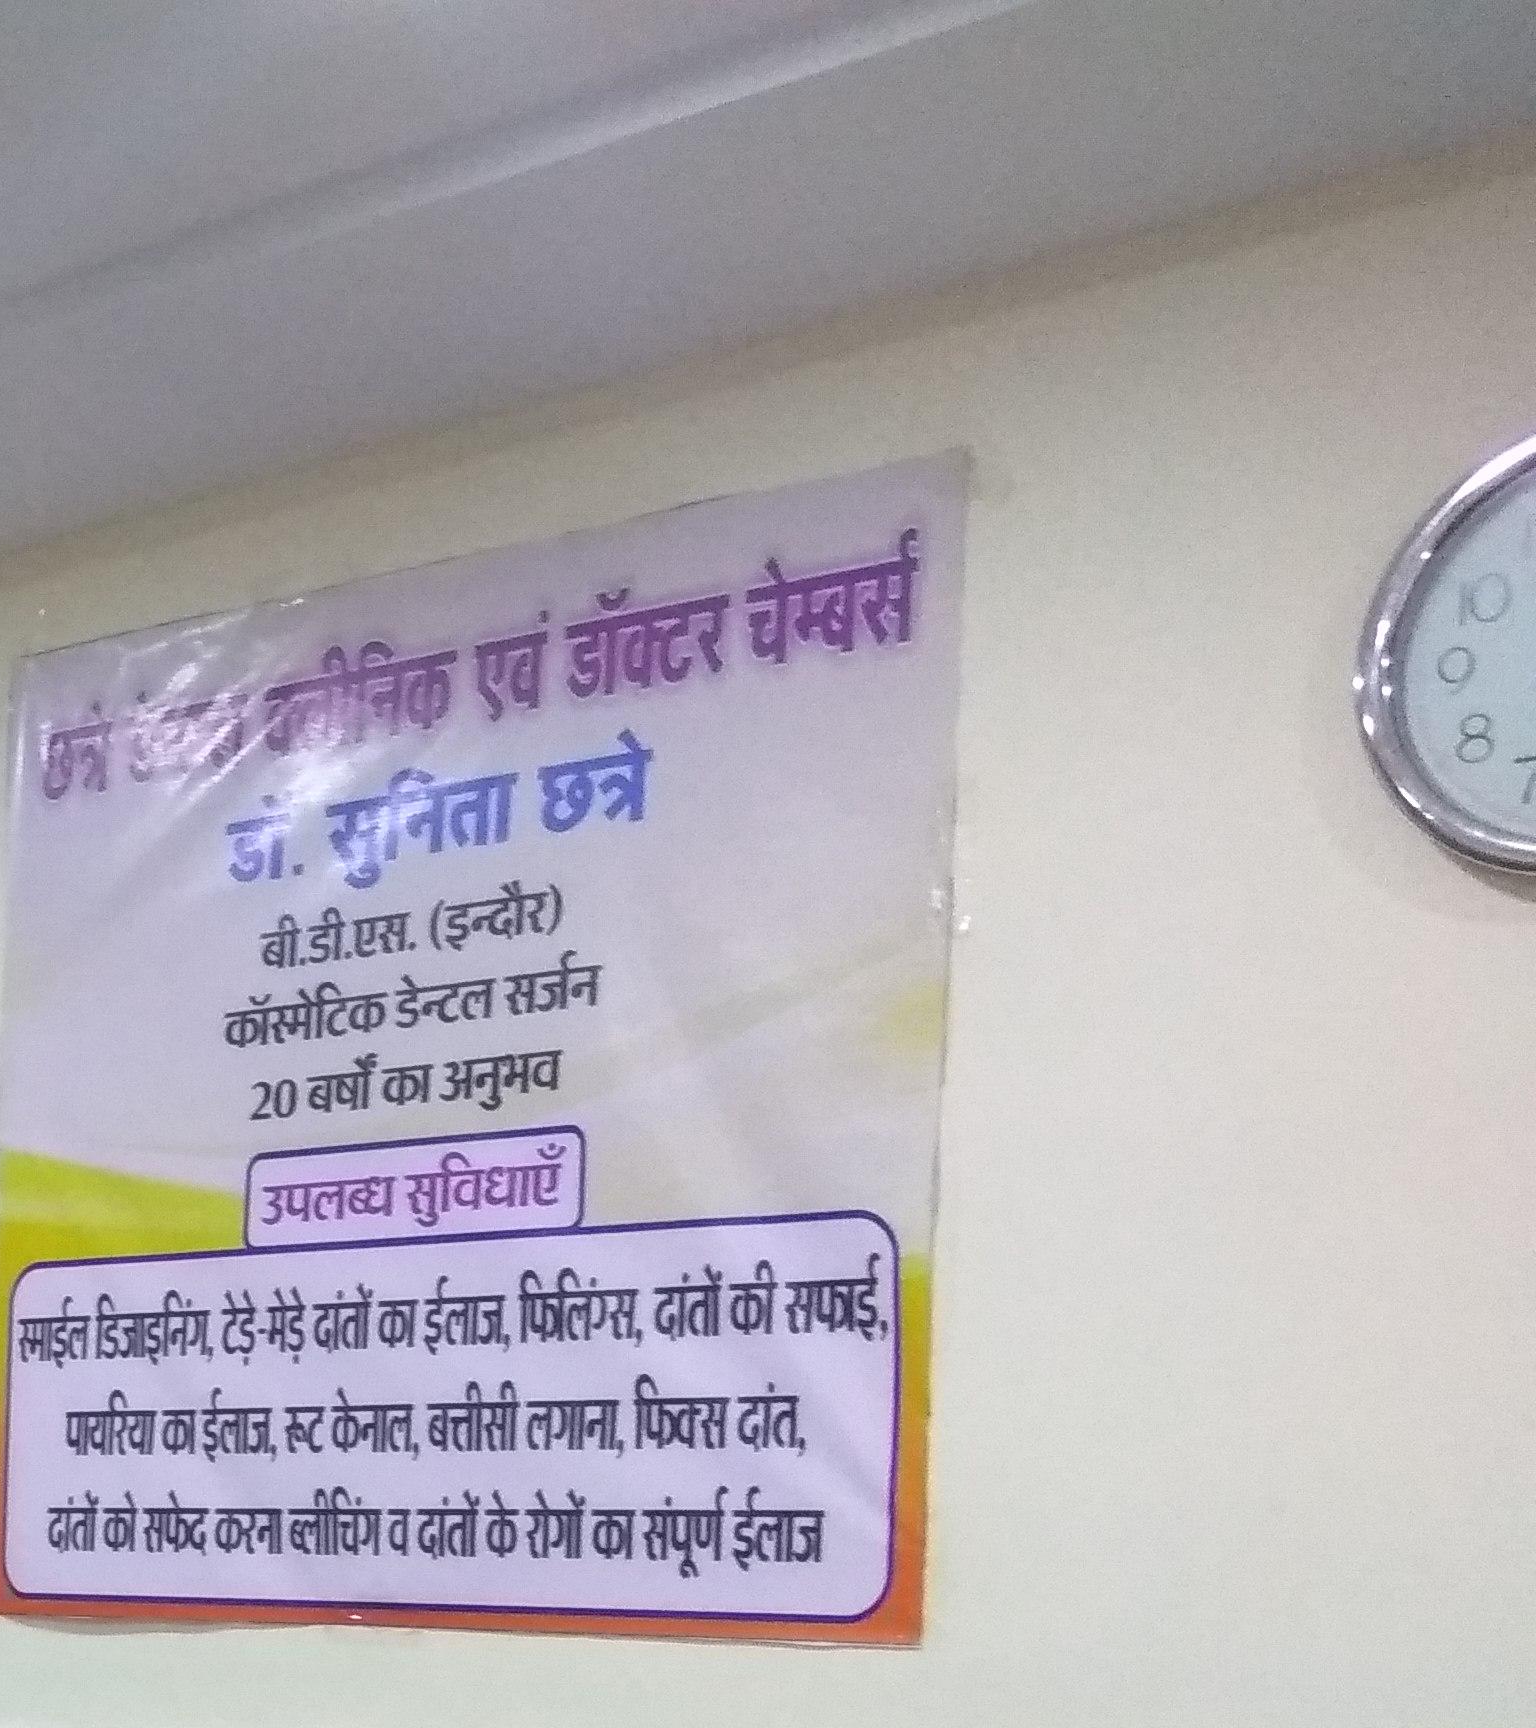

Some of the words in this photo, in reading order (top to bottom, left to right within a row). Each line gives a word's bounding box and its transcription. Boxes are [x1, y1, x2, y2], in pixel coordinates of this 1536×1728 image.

[475, 610, 548, 722] एवं
[565, 587, 730, 699] डॉक्टर
[745, 528, 920, 664] चेम्बर्स
[1437, 647, 1476, 696] 9
[1454, 713, 1495, 763] 8
[325, 767, 520, 889] सुनिता
[538, 729, 653, 833] छत्रे
[260, 907, 417, 968] बी.डी.एस.
[430, 880, 563, 950] (इन्दौर)
[224, 982, 390, 1048] कॉस्मेटिक
[395, 974, 496, 1028] डेन्टल
[503, 949, 603, 1016] सर्जन
[250, 1078, 298, 1121] 20
[381, 1063, 434, 1106] का
[439, 1050, 563, 1111] अनुभव
[261, 1175, 395, 1225] उपलब्ध
[404, 1142, 567, 1227] सुविधाएँ
[18, 1295, 91, 1369] स्माईल
[94, 1289, 214, 1366] डिजाइनिंग,
[312, 1282, 374, 1354] दांतों
[378, 1299, 419, 1349] का
[424, 1275, 511, 1355] ईलाज,
[653, 1263, 723, 1341] दांतों
[729, 1259, 778, 1336] की
[785, 1252, 889, 1342] सफाई,
[65, 1389, 157, 1456] पायरिया
[161, 1409, 196, 1455] का
[201, 1387, 277, 1463] ईलाज,
[285, 1406, 326, 1455] रूट
[331, 1387, 420, 1461] केनाल,
[427, 1380, 520, 1453] बत्तीसी
[526, 1399, 626, 1459] लगाना,
[634, 1374, 730, 1451] फिक्स
[737, 1381, 807, 1458] दांत,
[47, 1490, 99, 1555] दांतों
[103, 1490, 138, 1553] को
[143, 1489, 209, 1556] सफेद
[215, 1508, 282, 1556] करना
[288, 1486, 382, 1556] ब्लीचिंग
[388, 1508, 411, 1556] व
[417, 1489, 479, 1560] दांतों
[484, 1489, 520, 1559] के
[525, 1489, 586, 1561] रोगों
[592, 1509, 636, 1560] का
[642, 1486, 730, 1579] संपूर्ण
[732, 1486, 826, 1572] ईलाज
